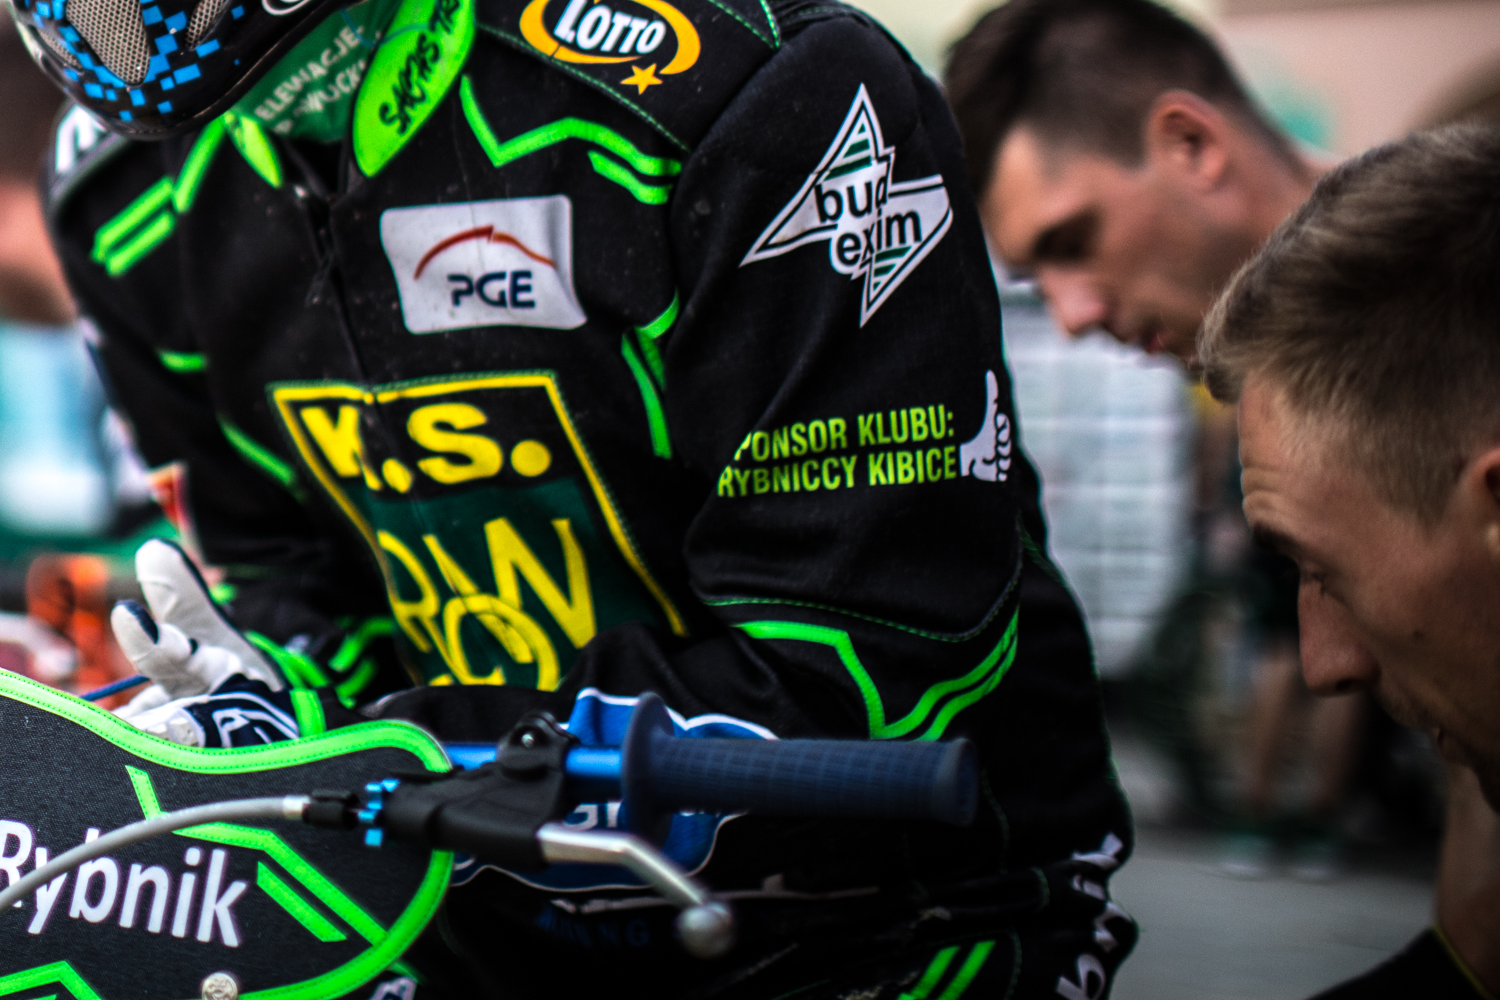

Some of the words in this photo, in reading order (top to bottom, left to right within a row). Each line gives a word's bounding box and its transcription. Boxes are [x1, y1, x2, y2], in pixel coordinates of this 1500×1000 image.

[813, 166, 890, 223] bud
[835, 208, 923, 267] exim
[446, 270, 536, 309] PGE
[733, 416, 848, 462] PONSOR
[857, 403, 954, 447] KLUBU:
[716, 455, 858, 498] RYBNICCY
[867, 445, 957, 487] KIBICE
